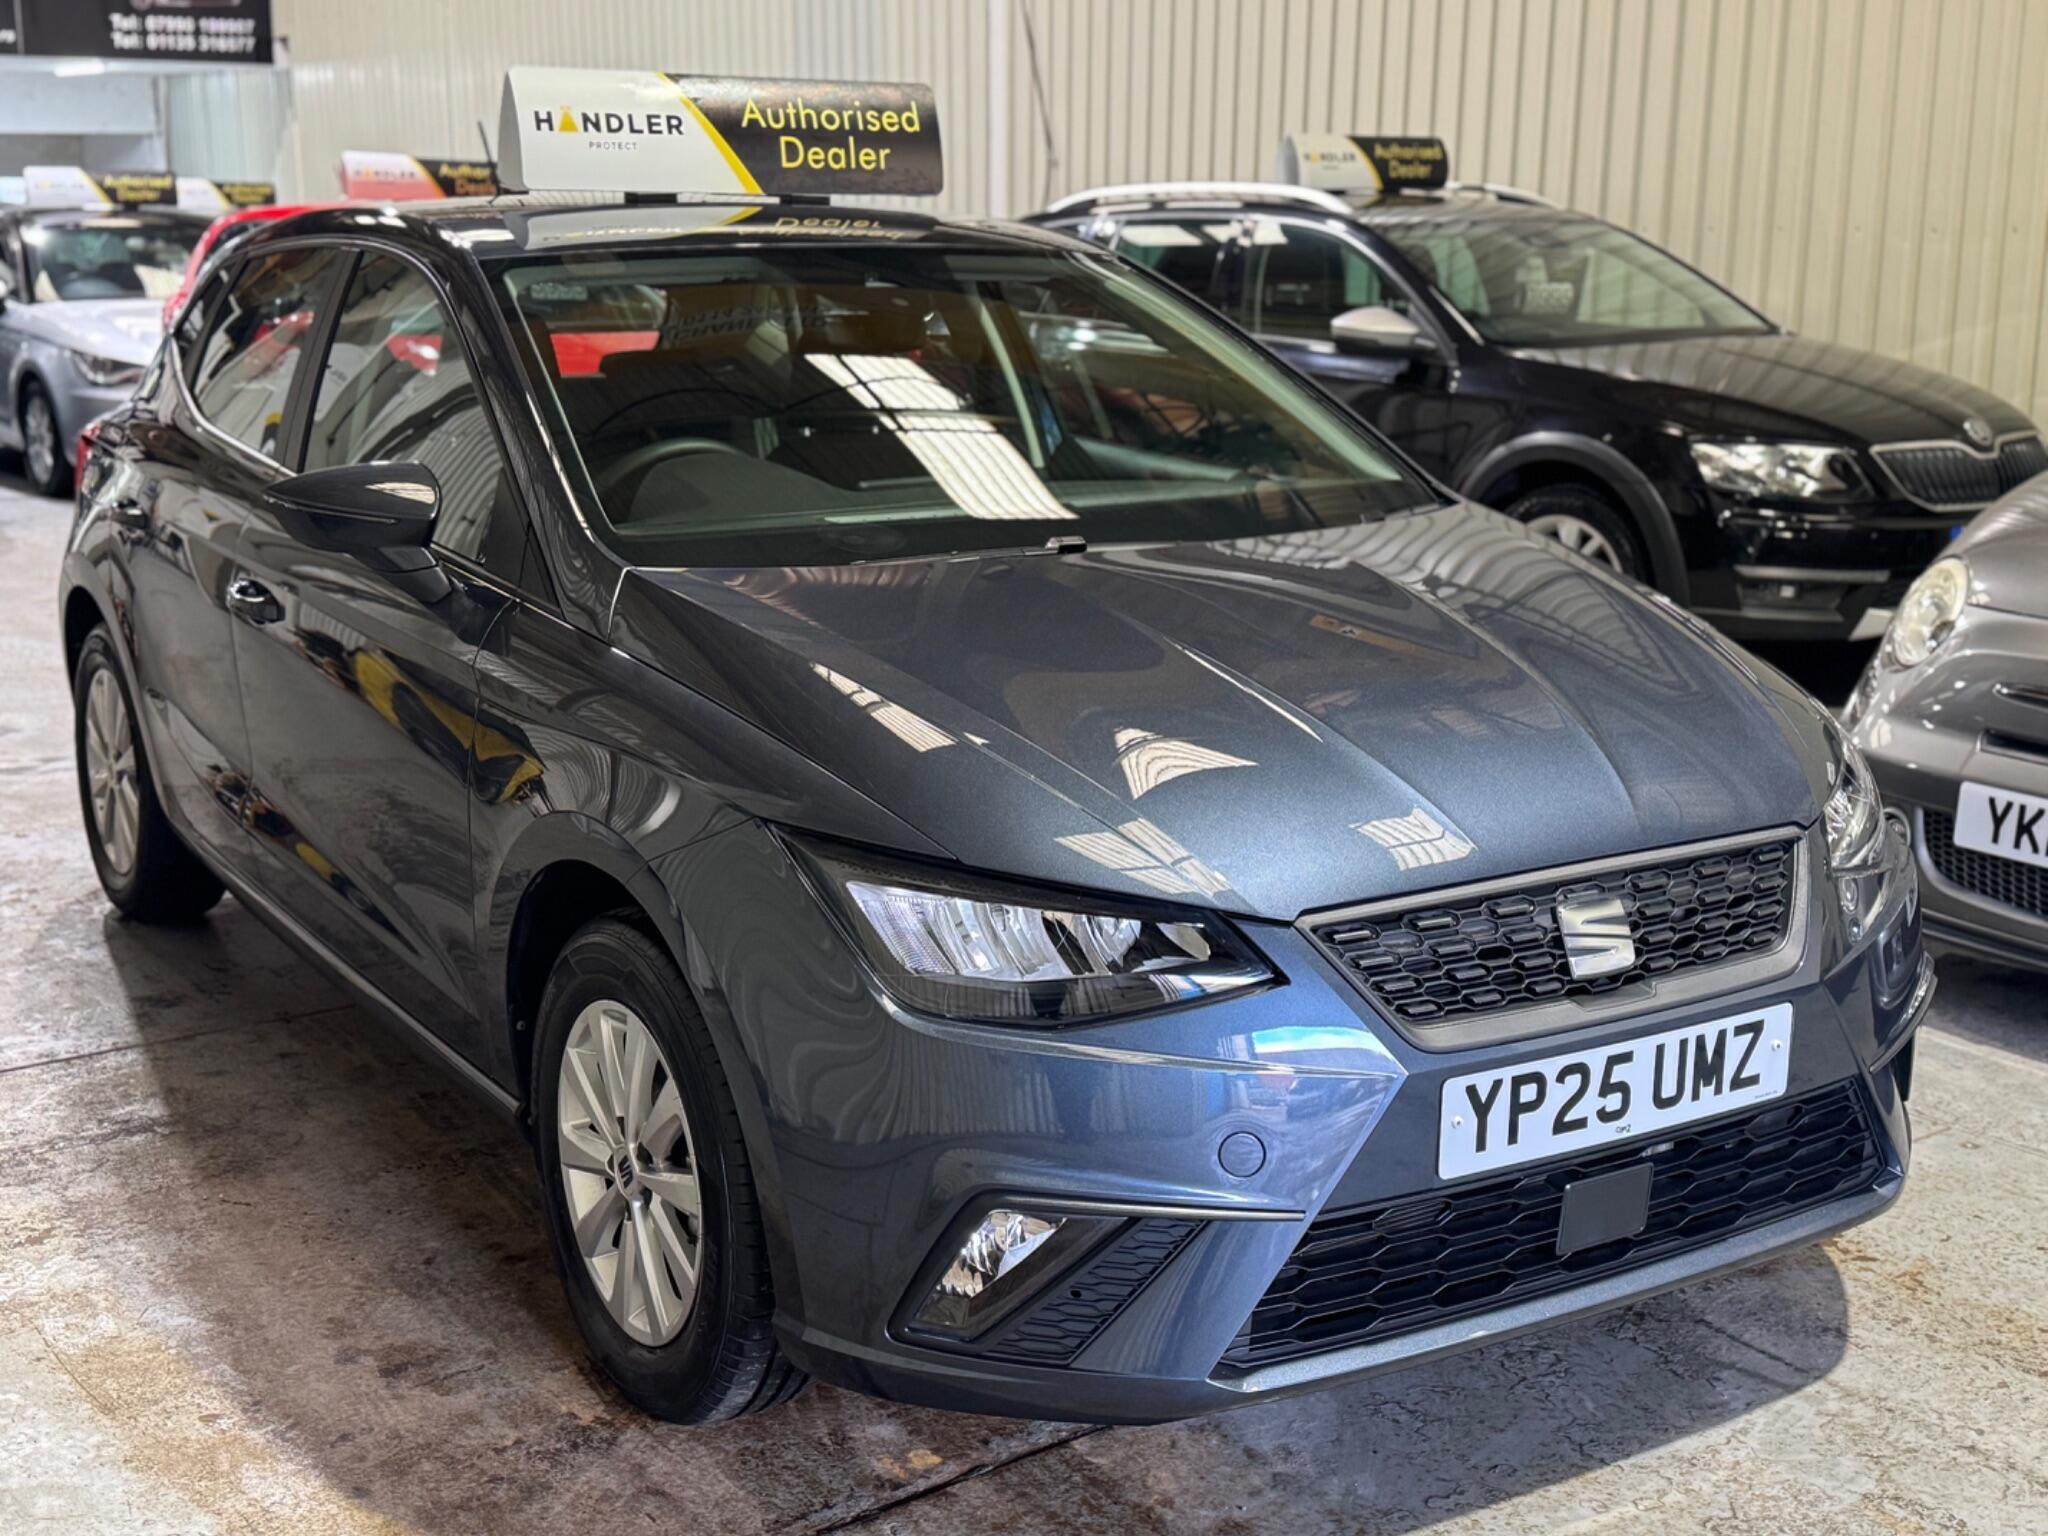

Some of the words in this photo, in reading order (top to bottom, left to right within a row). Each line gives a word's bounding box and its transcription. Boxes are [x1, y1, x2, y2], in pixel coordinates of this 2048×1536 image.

[741, 97, 920, 133] Authorised
[589, 141, 637, 150] PROTECT
[779, 135, 891, 170] Dealer
[1988, 796, 2048, 857] YK
[1465, 1050, 1634, 1153] YP25
[1652, 1019, 1765, 1110] UMZ
